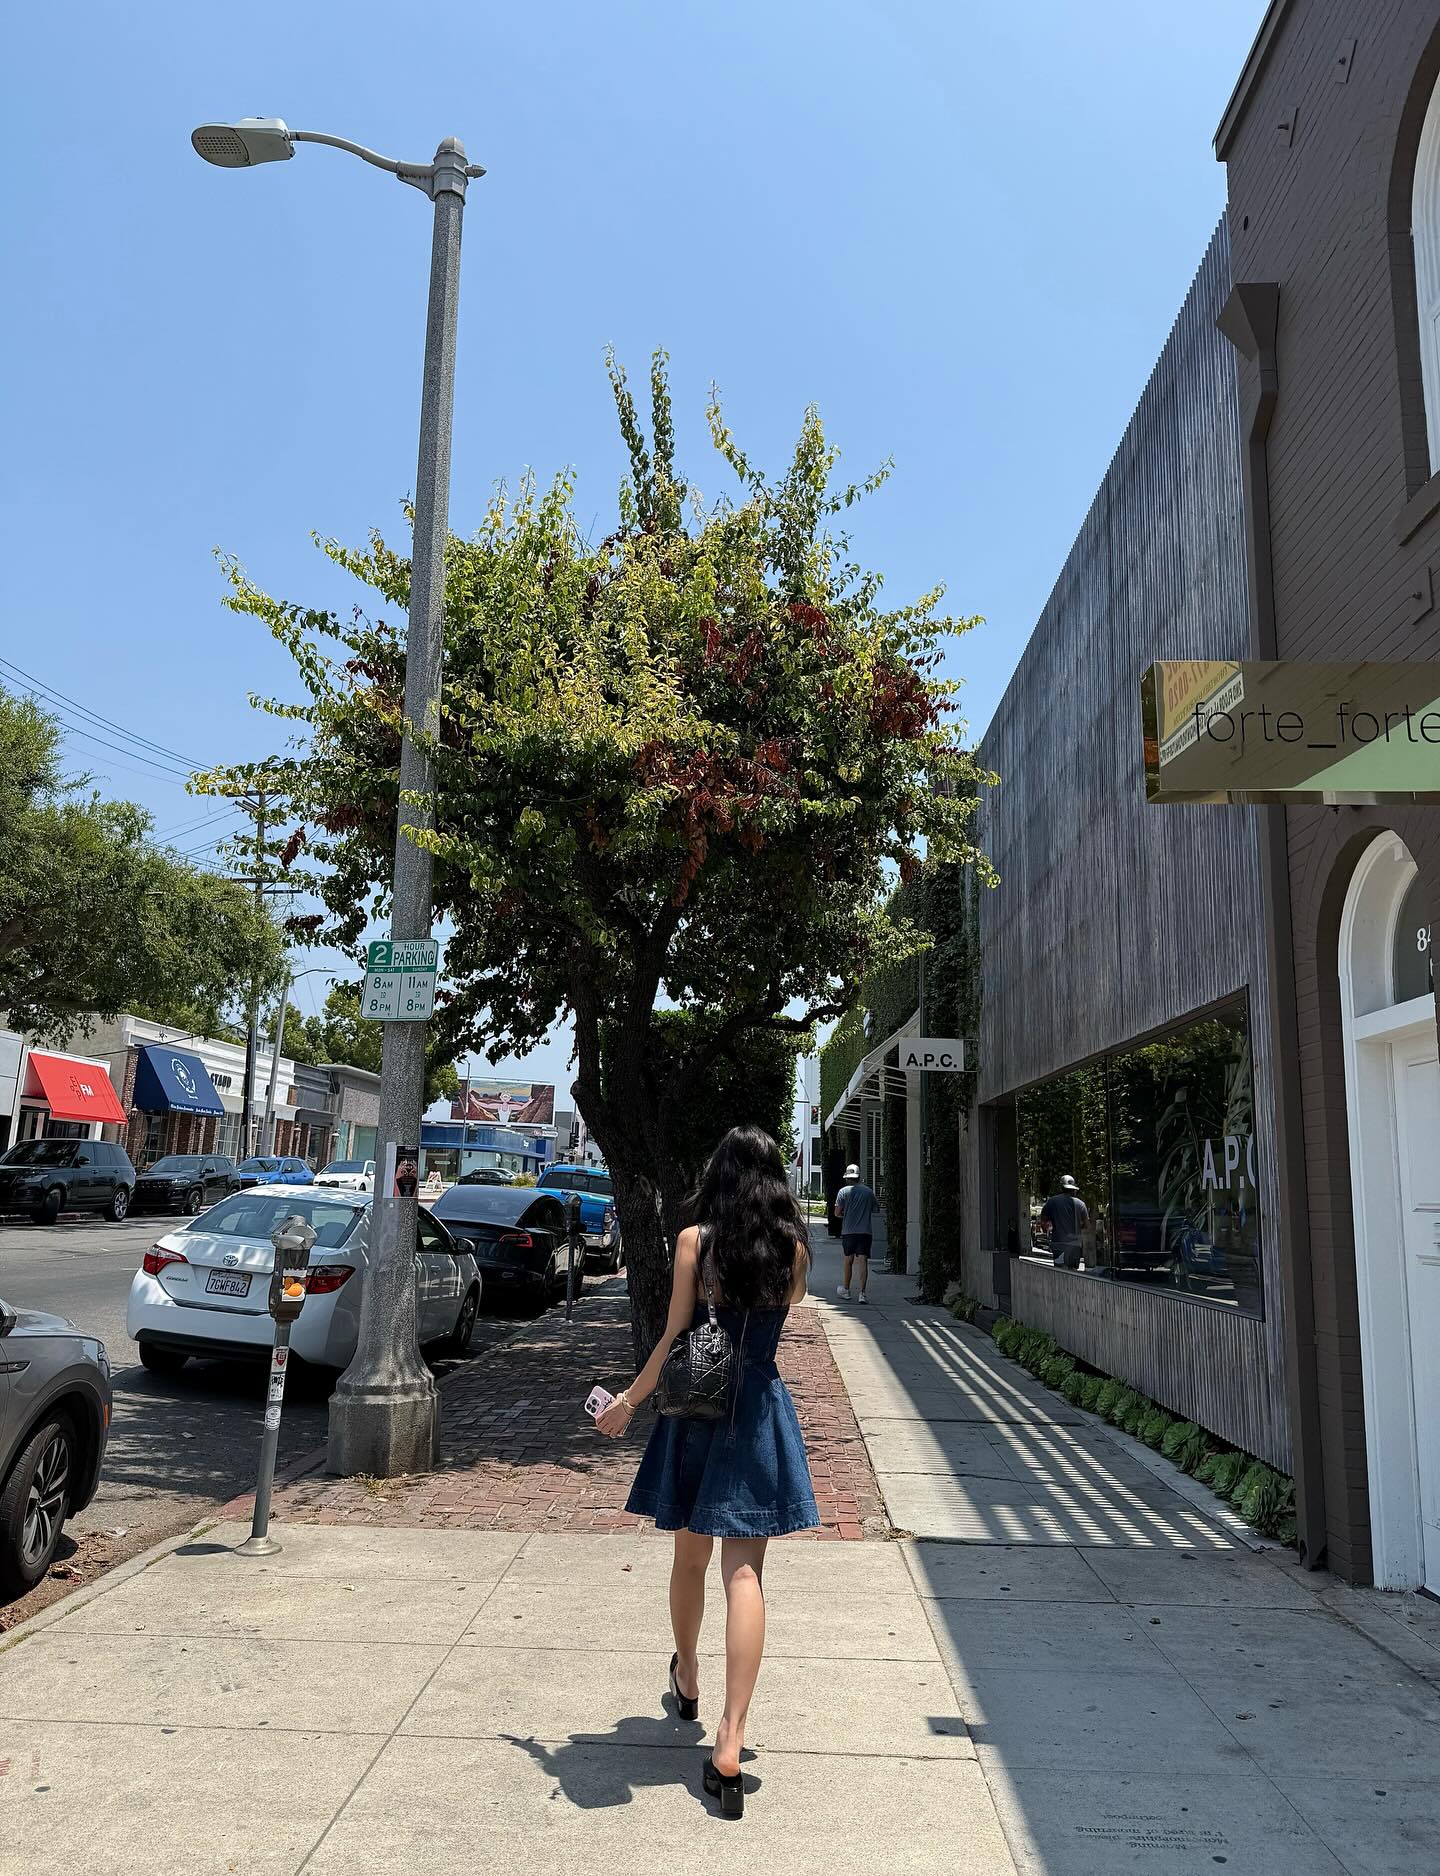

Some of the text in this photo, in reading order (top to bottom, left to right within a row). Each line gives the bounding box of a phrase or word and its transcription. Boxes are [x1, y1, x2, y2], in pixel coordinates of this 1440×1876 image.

[1191, 702, 1440, 749] forte_forte
[374, 943, 426, 963] 2 HOUR
[393, 950, 434, 966] PARKING
[906, 1053, 958, 1069] A.P.C.
[210, 1278, 247, 1293] 7GWF842
